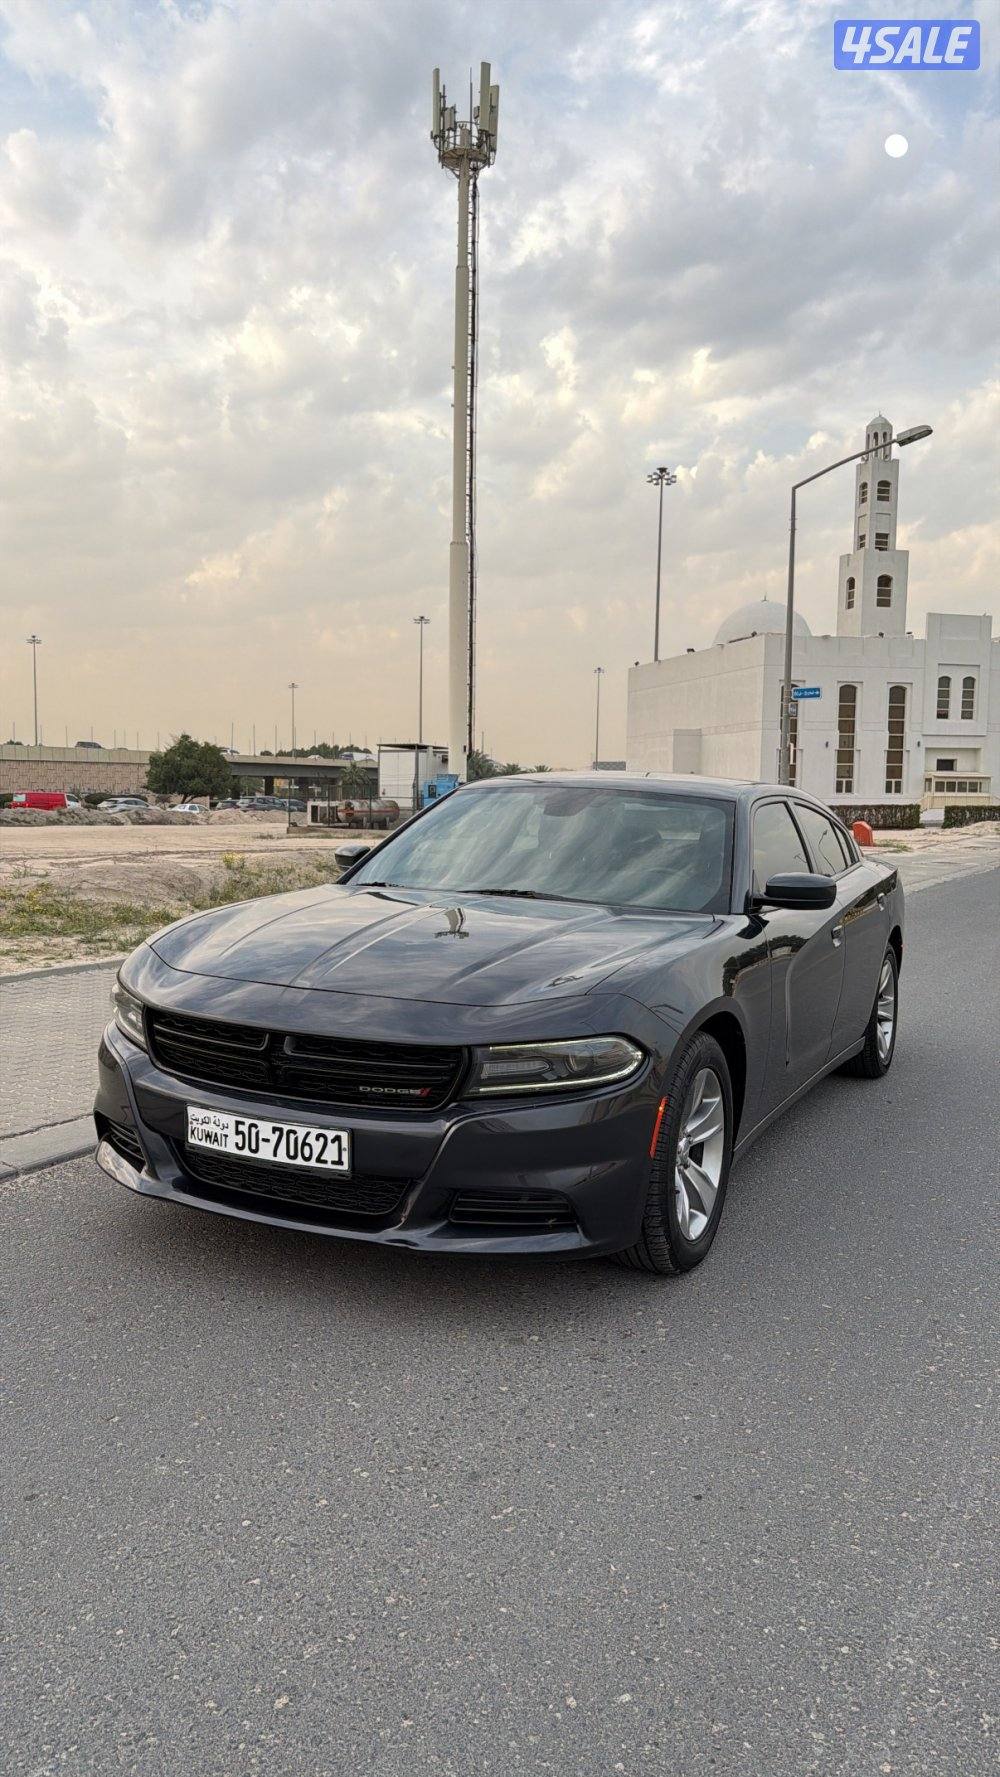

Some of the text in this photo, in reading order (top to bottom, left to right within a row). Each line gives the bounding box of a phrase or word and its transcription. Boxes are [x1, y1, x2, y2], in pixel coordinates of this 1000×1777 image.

[359, 1086, 421, 1095] DODGE
[190, 1113, 229, 1131] دولة الكويت
[190, 1125, 229, 1148] KUWAIT
[234, 1119, 345, 1167] 50-70621
